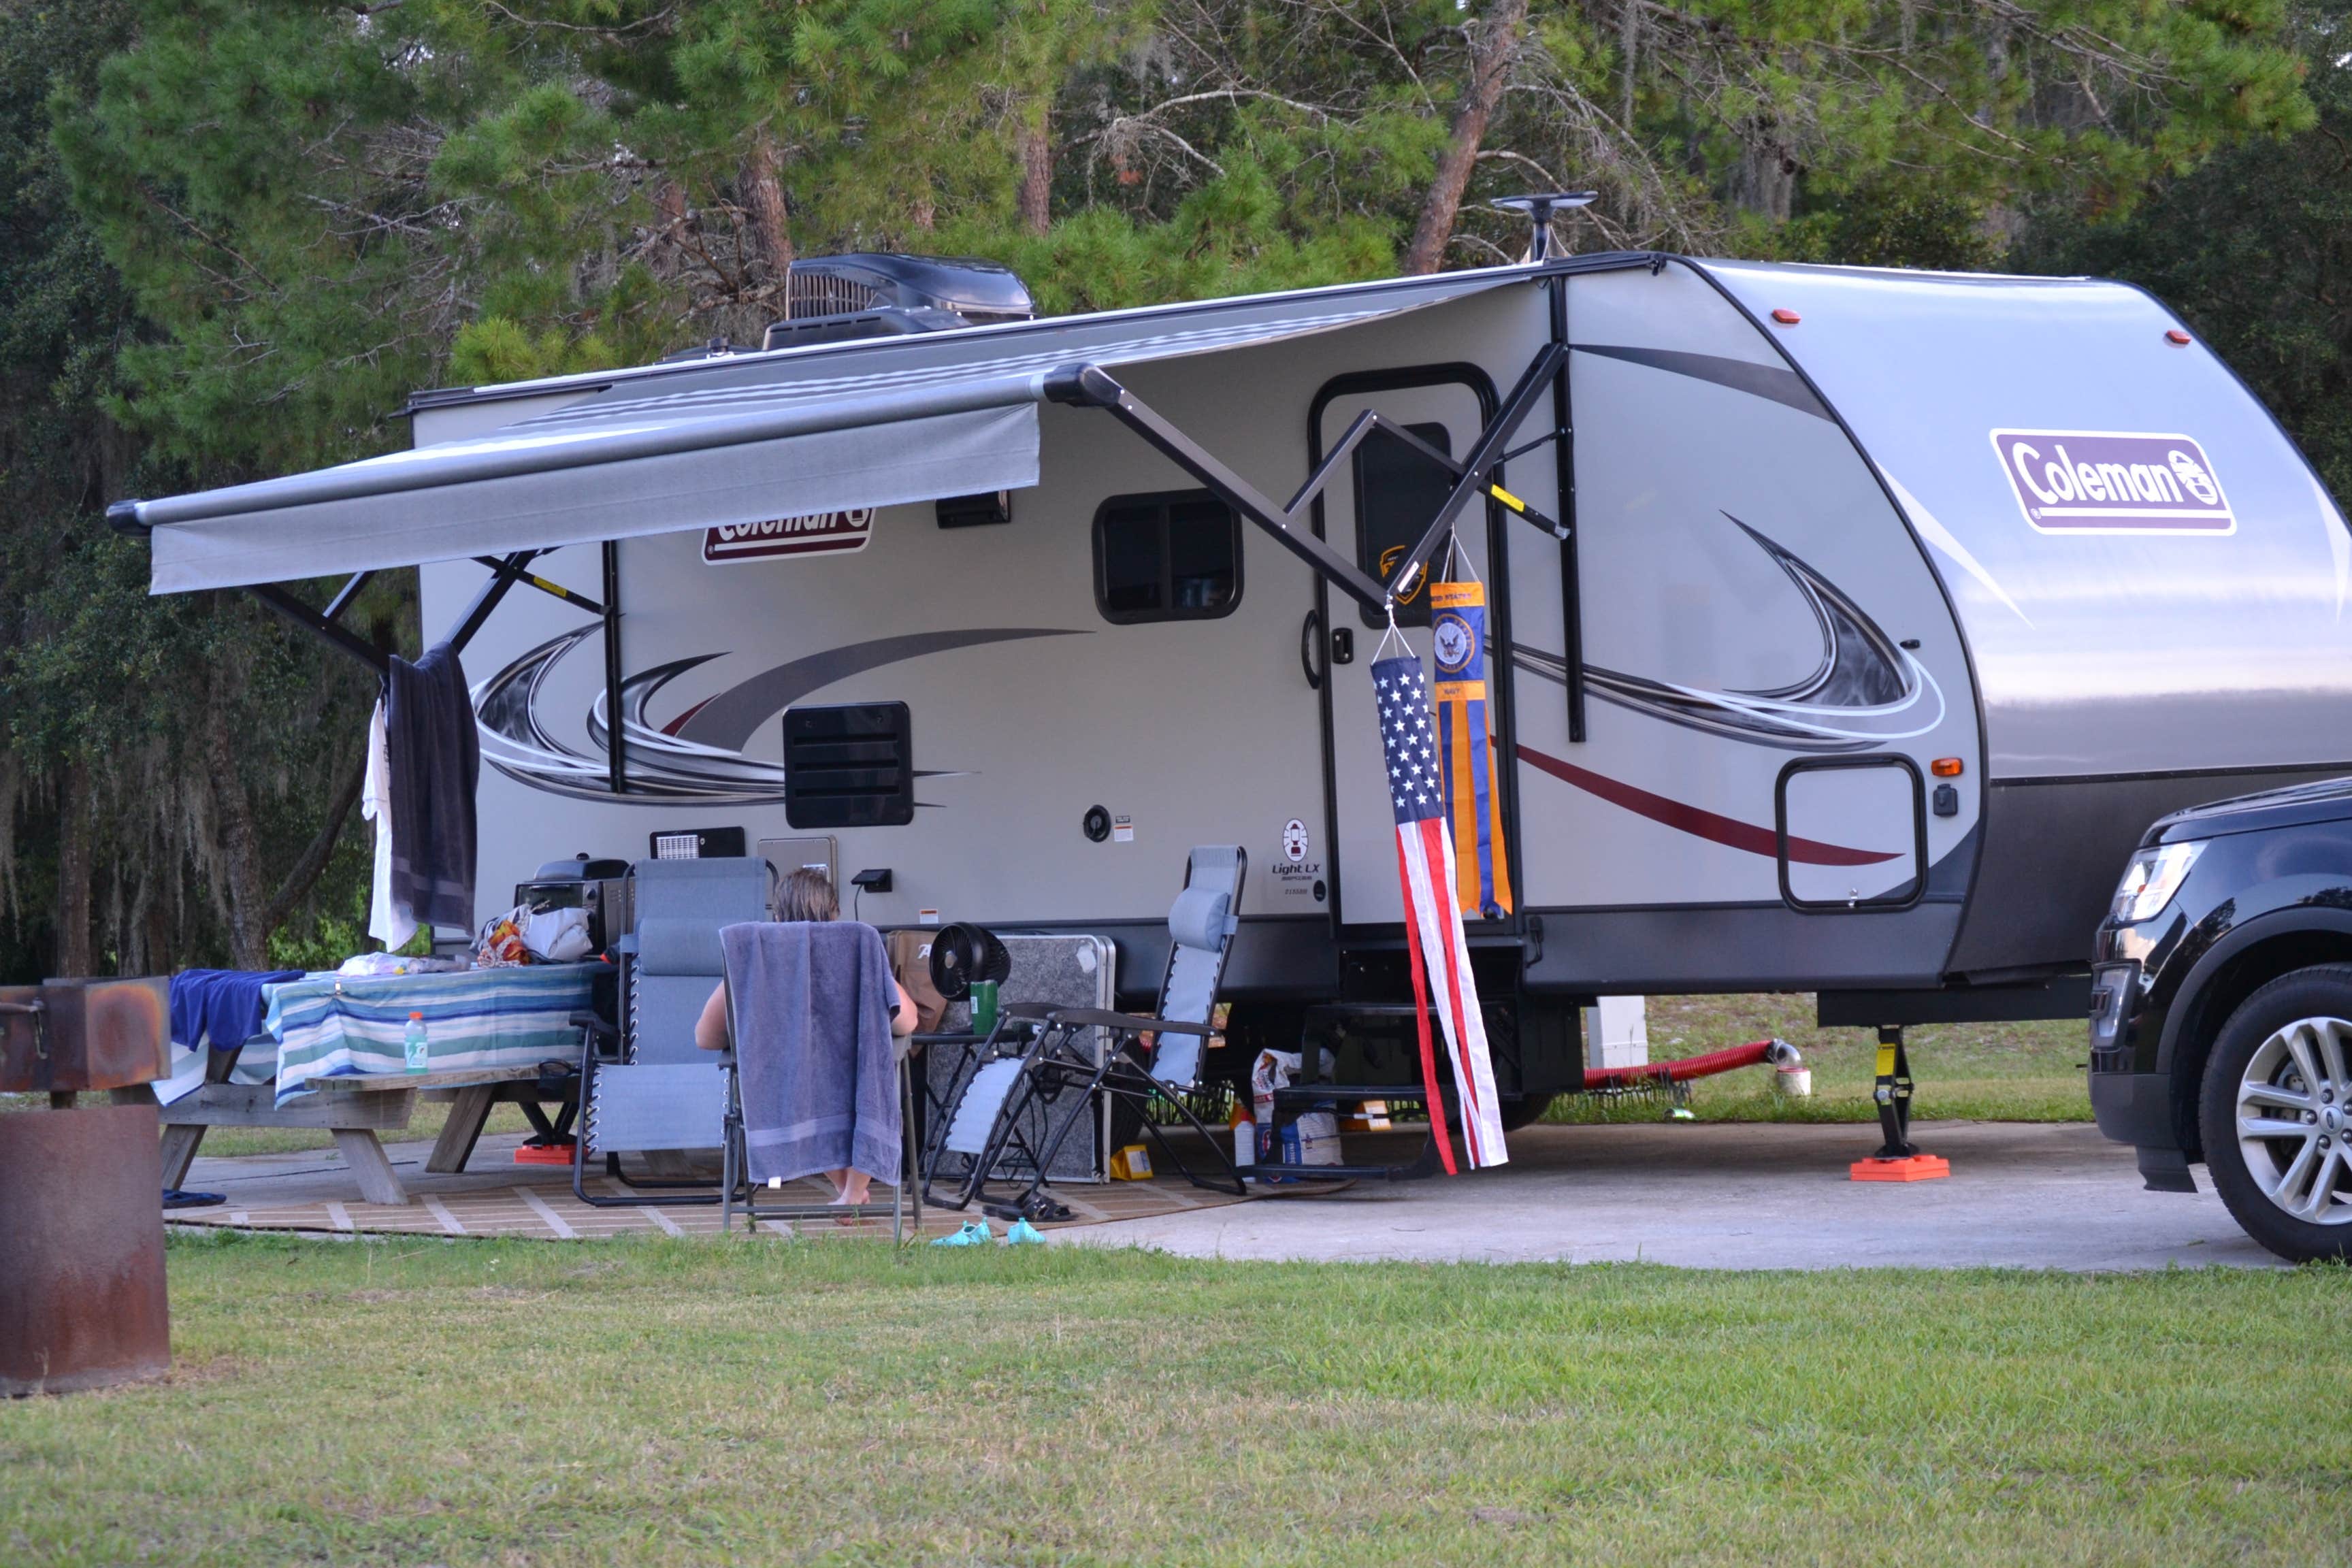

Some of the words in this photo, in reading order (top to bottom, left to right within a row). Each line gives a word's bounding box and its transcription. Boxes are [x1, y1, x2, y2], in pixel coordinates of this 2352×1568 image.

[2012, 442, 2184, 505] Coleman
[1272, 862, 1303, 875] Light
[1305, 864, 1321, 873] LX
